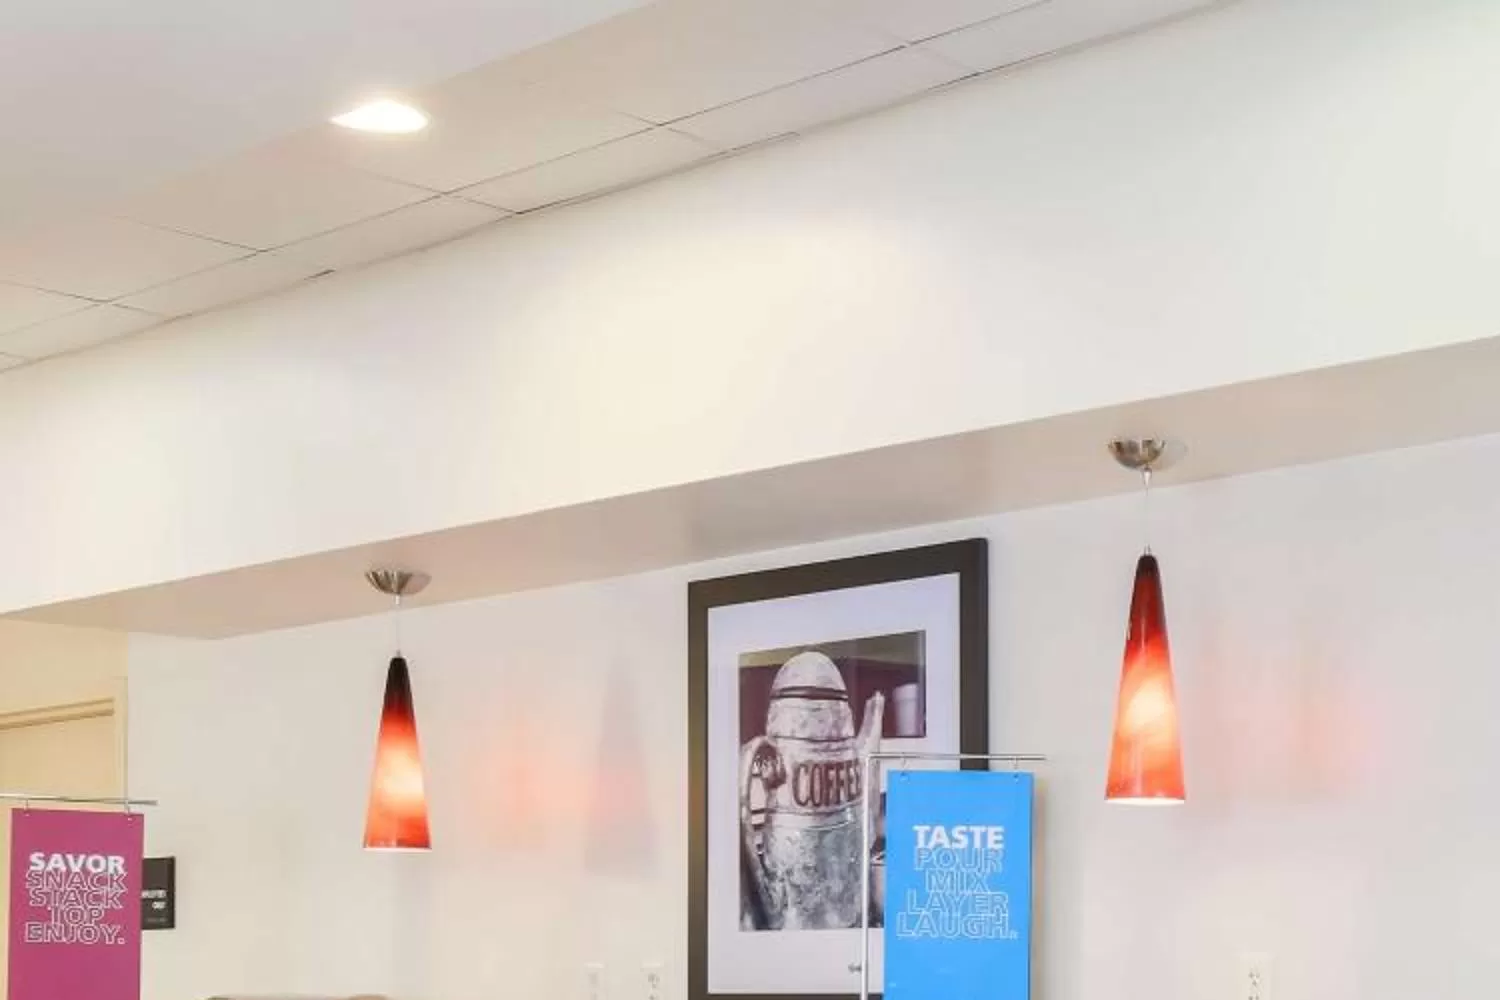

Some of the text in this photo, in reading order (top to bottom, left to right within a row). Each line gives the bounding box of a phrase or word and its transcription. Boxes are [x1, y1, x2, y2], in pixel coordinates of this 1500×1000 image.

[912, 825, 1004, 849] TASTE
[29, 853, 125, 874] SAVOR
[914, 847, 1003, 872] POUR
[26, 869, 128, 893] SNACK
[925, 867, 990, 894] MIX
[29, 887, 124, 910] STACK
[906, 888, 1008, 915] LAYER
[48, 905, 104, 926] TOP
[896, 911, 1018, 940] LAUGH.
[25, 921, 125, 945] ENJOY.
